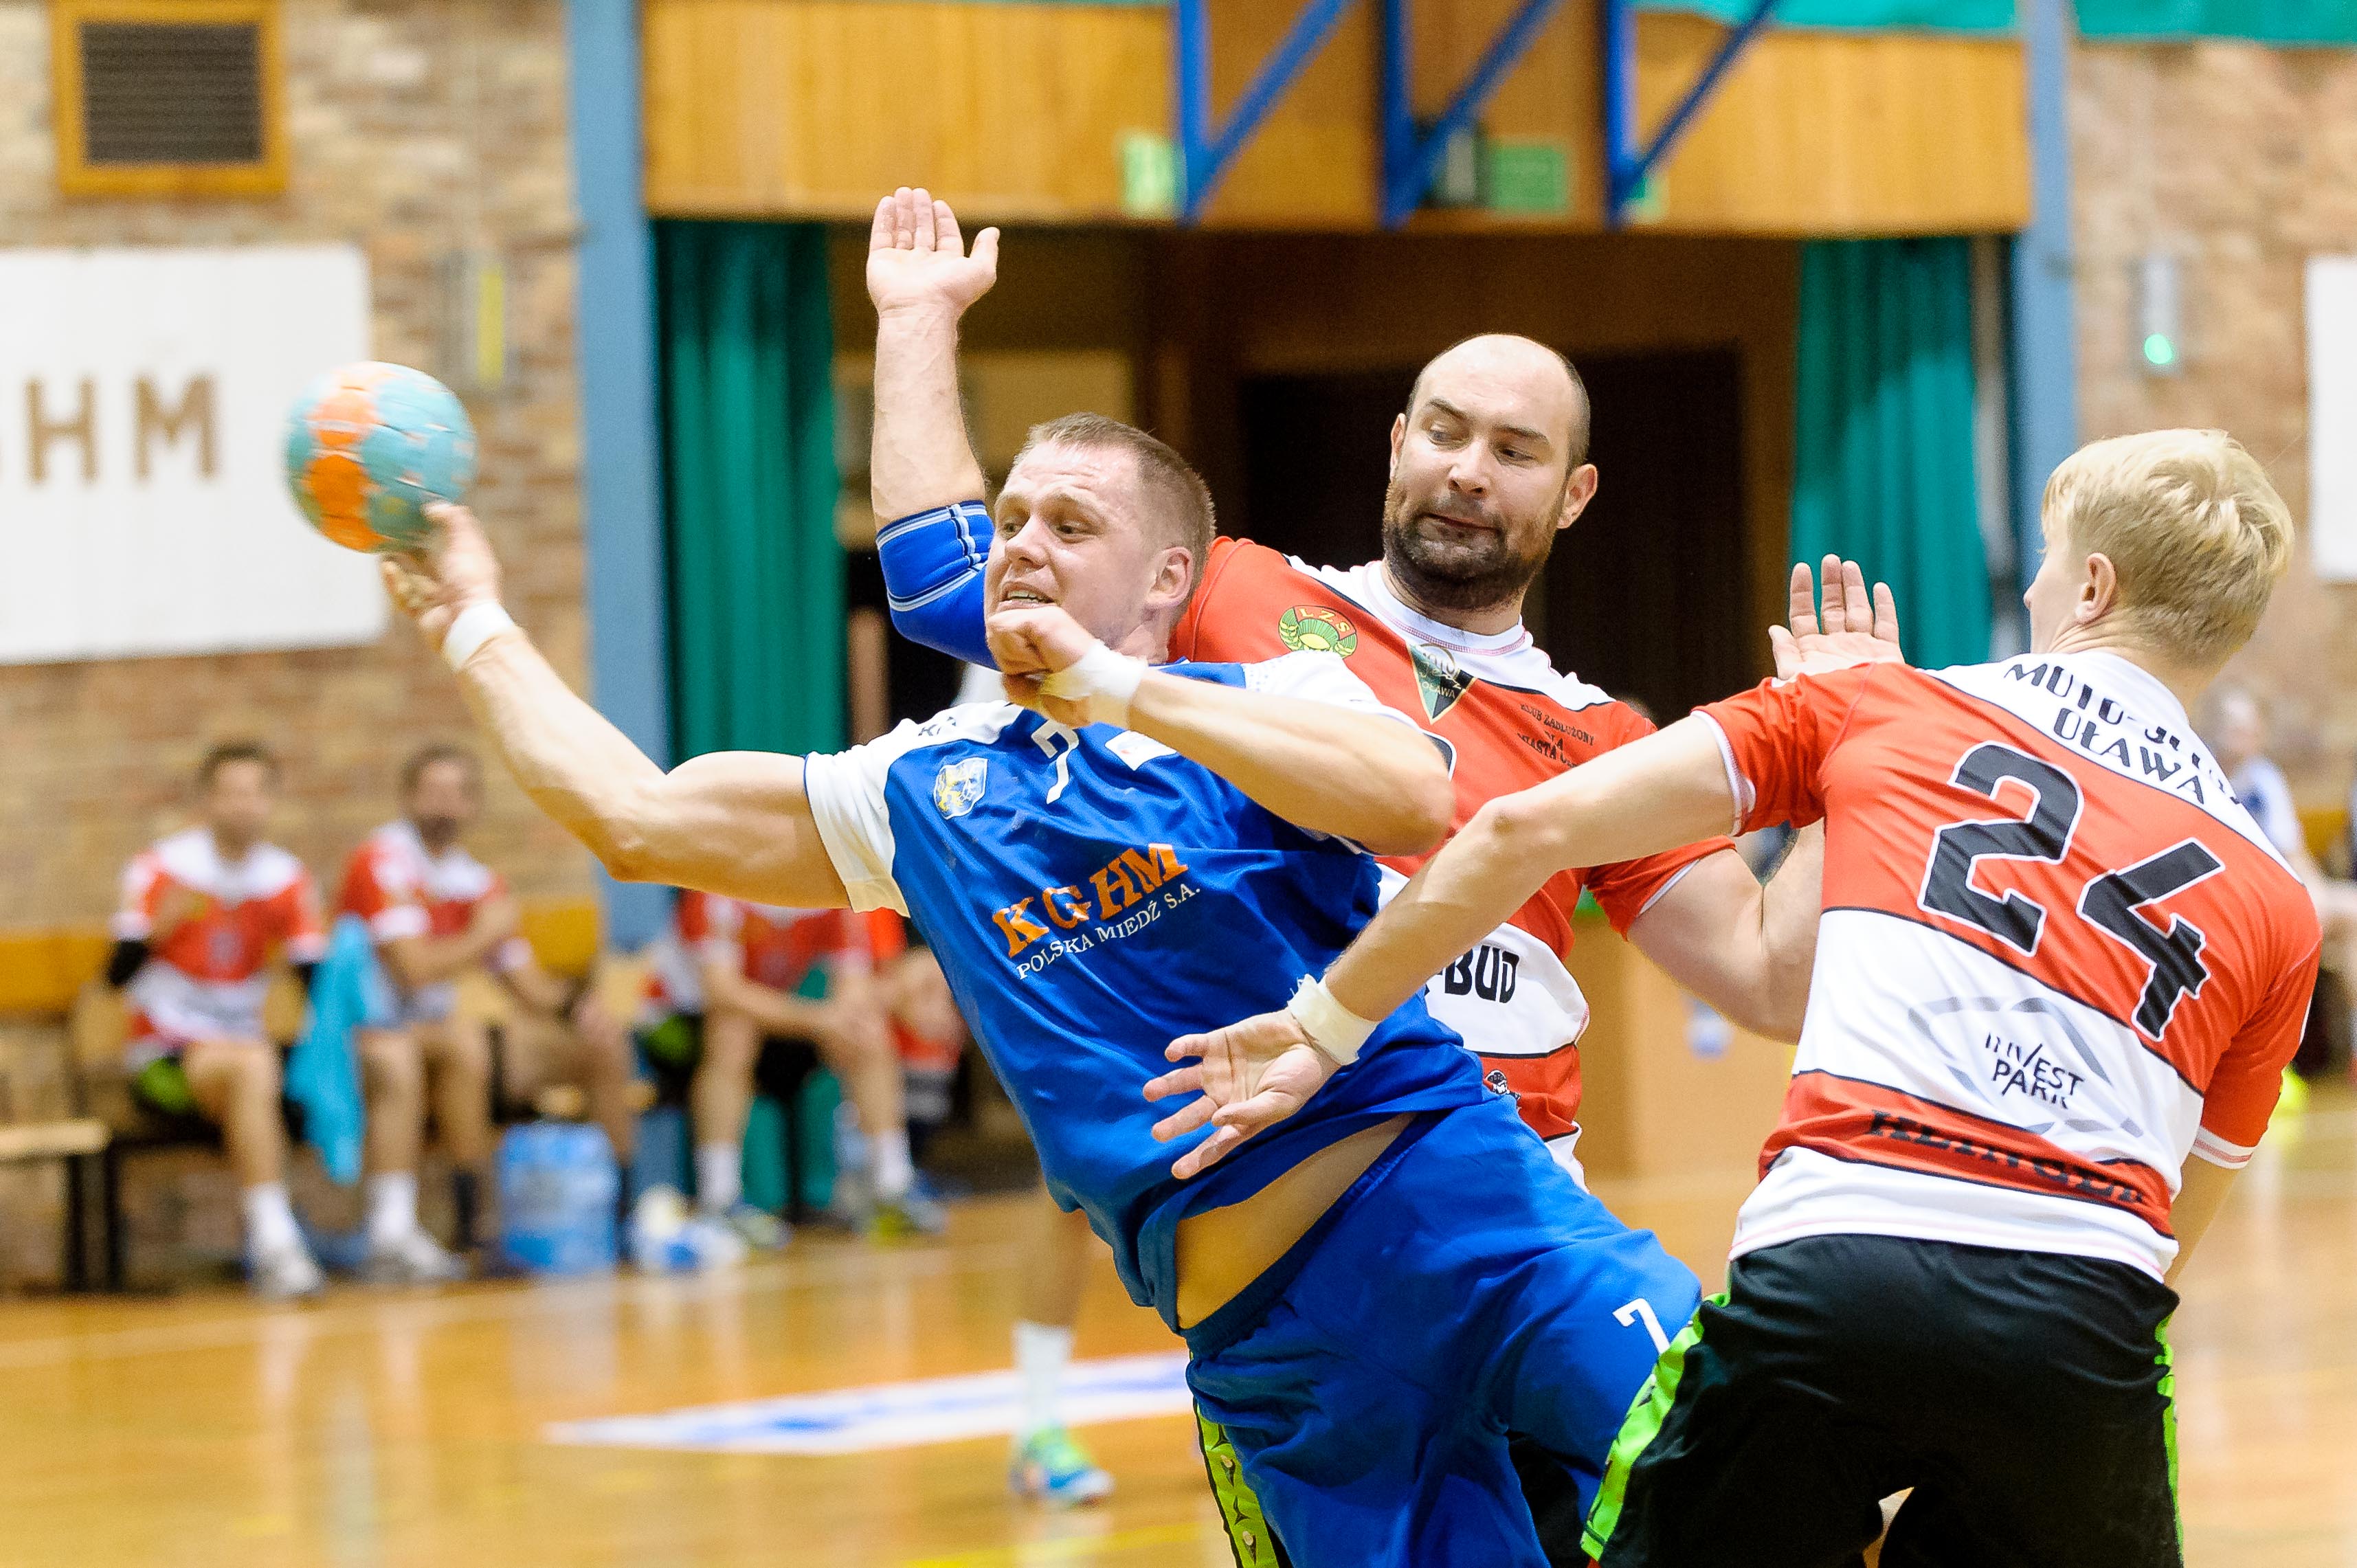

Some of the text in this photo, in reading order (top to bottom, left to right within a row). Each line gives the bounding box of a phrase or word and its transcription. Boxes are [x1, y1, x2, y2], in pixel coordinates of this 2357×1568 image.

[1298, 607, 1350, 632] LZS
[1031, 719, 1080, 804] 7
[2053, 708, 2204, 804] OŁAWA
[992, 842, 1189, 958] KGHM
[1016, 883, 1200, 980] POLSKA MIEDŹ S.A.
[1918, 741, 2226, 1042] 24
[1992, 1058, 2068, 1109] PARK
[1612, 1298, 1670, 1354] 7
